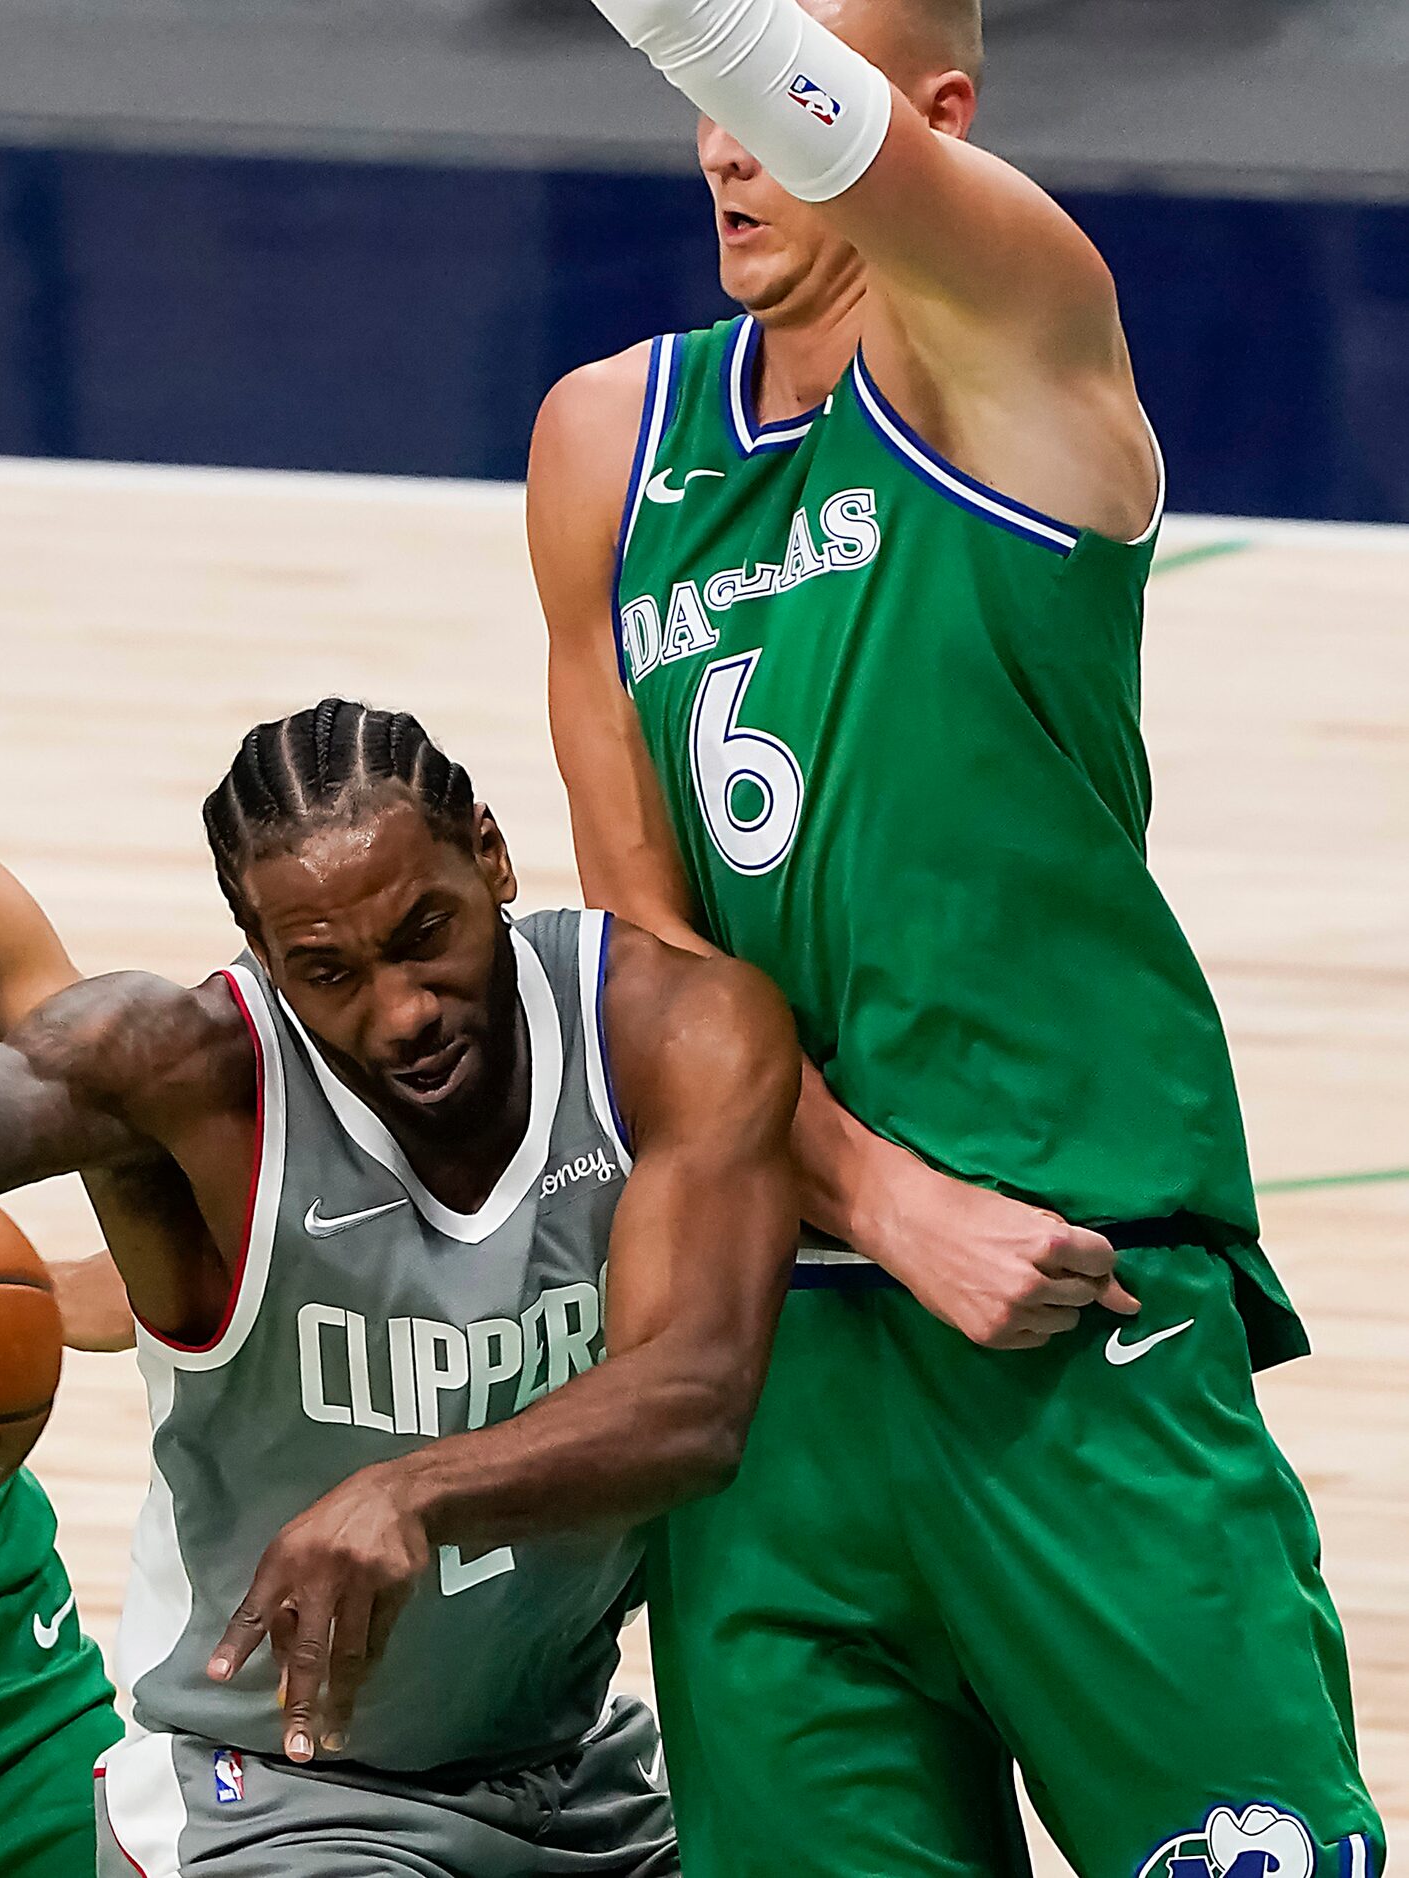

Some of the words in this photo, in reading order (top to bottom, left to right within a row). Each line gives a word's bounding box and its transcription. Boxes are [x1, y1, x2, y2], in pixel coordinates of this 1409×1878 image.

[690, 647, 805, 876] 6
[540, 1147, 616, 1199] oney
[297, 1280, 607, 1437] CLIPPER
